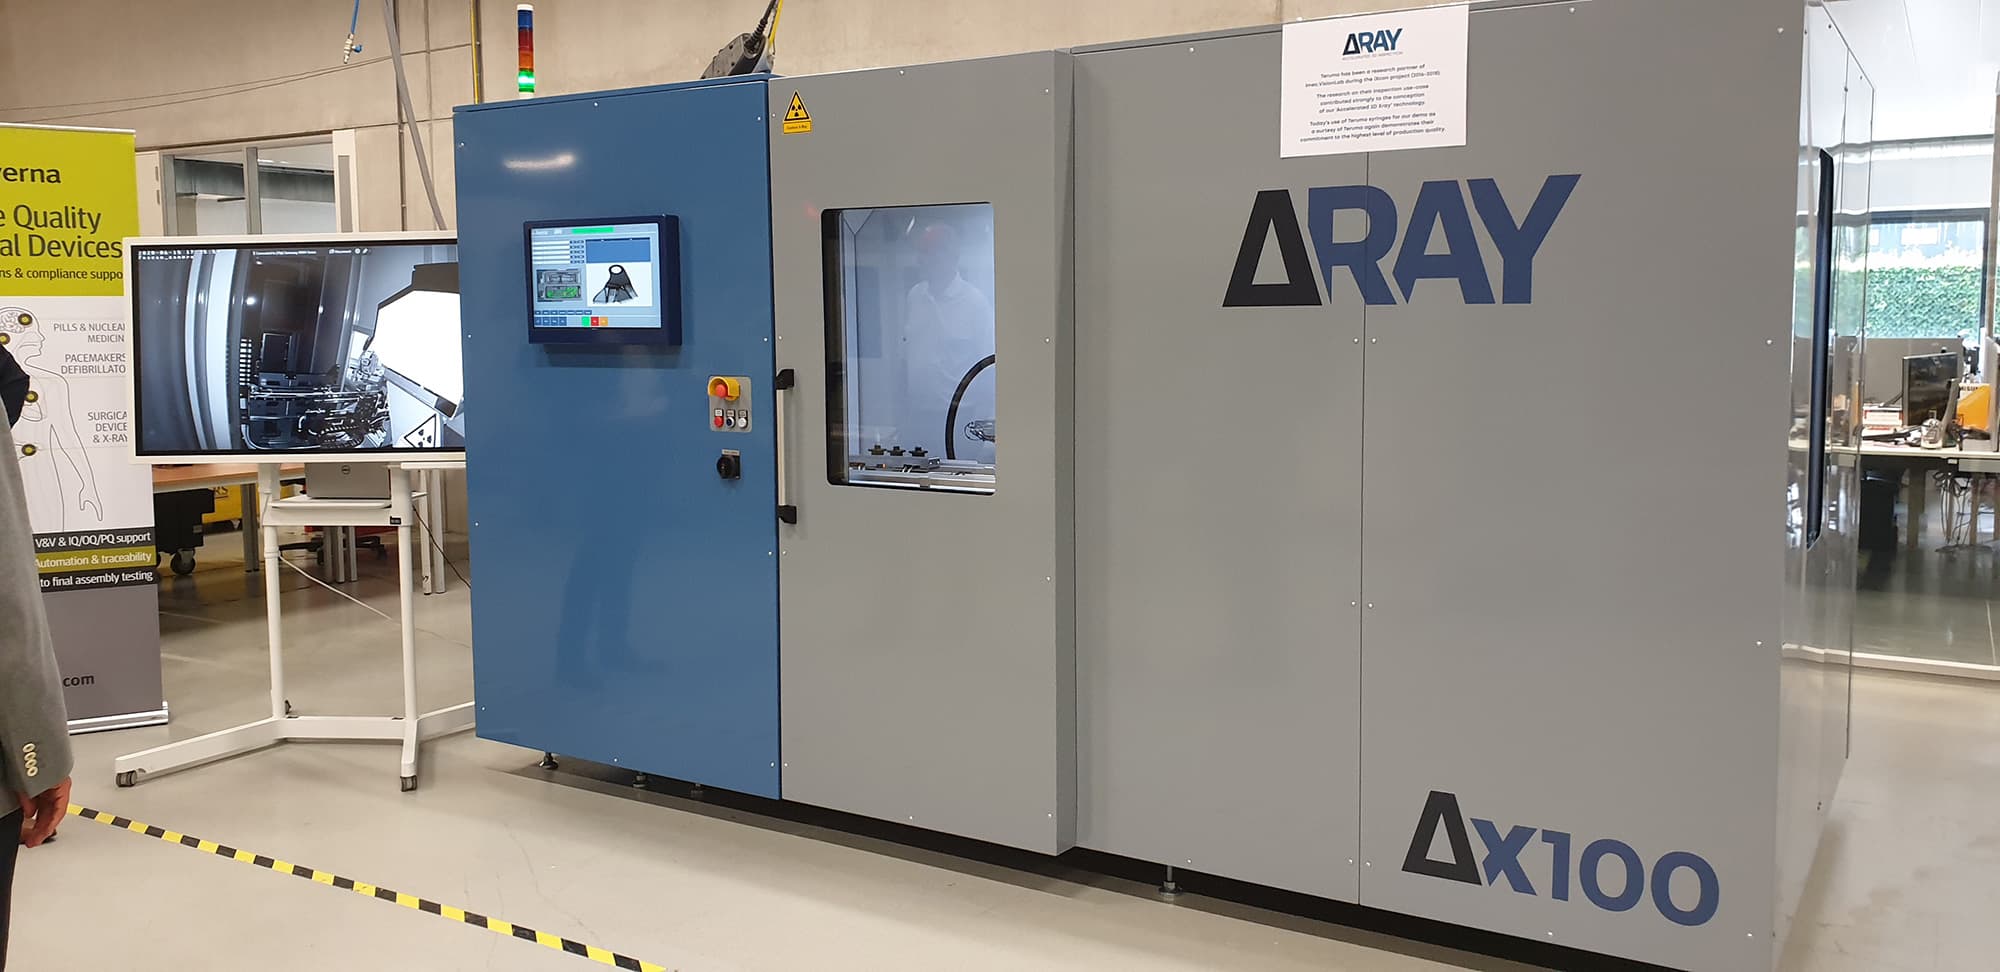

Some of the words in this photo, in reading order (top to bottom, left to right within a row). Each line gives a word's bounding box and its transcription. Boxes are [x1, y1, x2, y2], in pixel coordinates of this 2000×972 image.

[1320, 98, 1351, 106] contributed
[0, 167, 61, 184] erna
[13, 204, 101, 234] Quality
[28, 234, 123, 259] Devices
[14, 268, 23, 279] &
[26, 268, 88, 280] compliance
[53, 323, 77, 332] PILLS
[79, 323, 86, 332] &
[93, 434, 100, 443] &
[35, 537, 56, 548] V&V
[58, 536, 67, 547] &
[68, 533, 115, 547] IQ/OQ/PQ
[116, 532, 151, 545] support
[91, 554, 100, 565] &
[101, 551, 152, 564] traceability
[40, 577, 50, 588] to
[52, 575, 73, 586] final
[75, 572, 120, 585] assembly
[121, 570, 153, 582] testing
[62, 675, 95, 687] com
